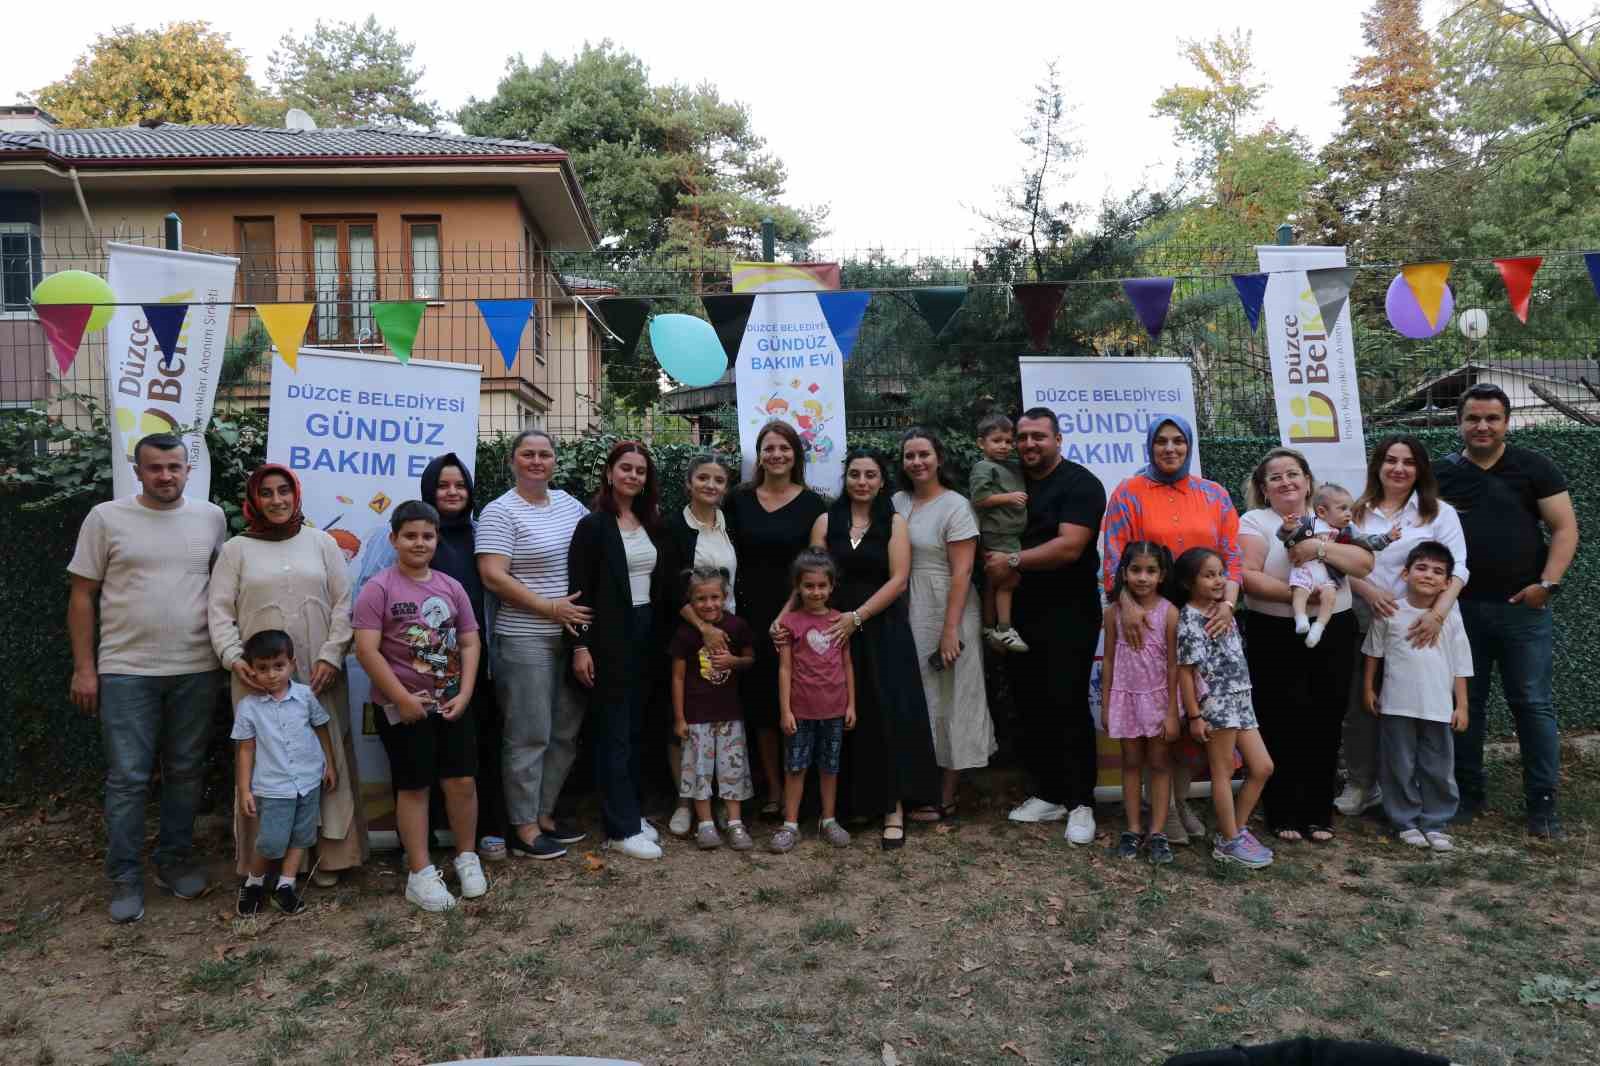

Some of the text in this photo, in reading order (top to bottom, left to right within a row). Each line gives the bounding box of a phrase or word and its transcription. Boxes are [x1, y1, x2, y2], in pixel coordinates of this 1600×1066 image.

[757, 335, 827, 352] GÜNDÜZ
[1284, 314, 1304, 385] Düzce
[118, 319, 149, 398] Düzce
[751, 351, 834, 370] BAKIM EVİ
[287, 384, 465, 413] DÜZCE BELEDİYESİ
[1035, 386, 1181, 402] DÜZCE BELEDİYESİ
[306, 410, 445, 446] GÜNDÜZ
[1057, 408, 1169, 434] GÜNDÜ
[289, 446, 396, 477] BAKIM
[1066, 443, 1134, 464] AKIM
